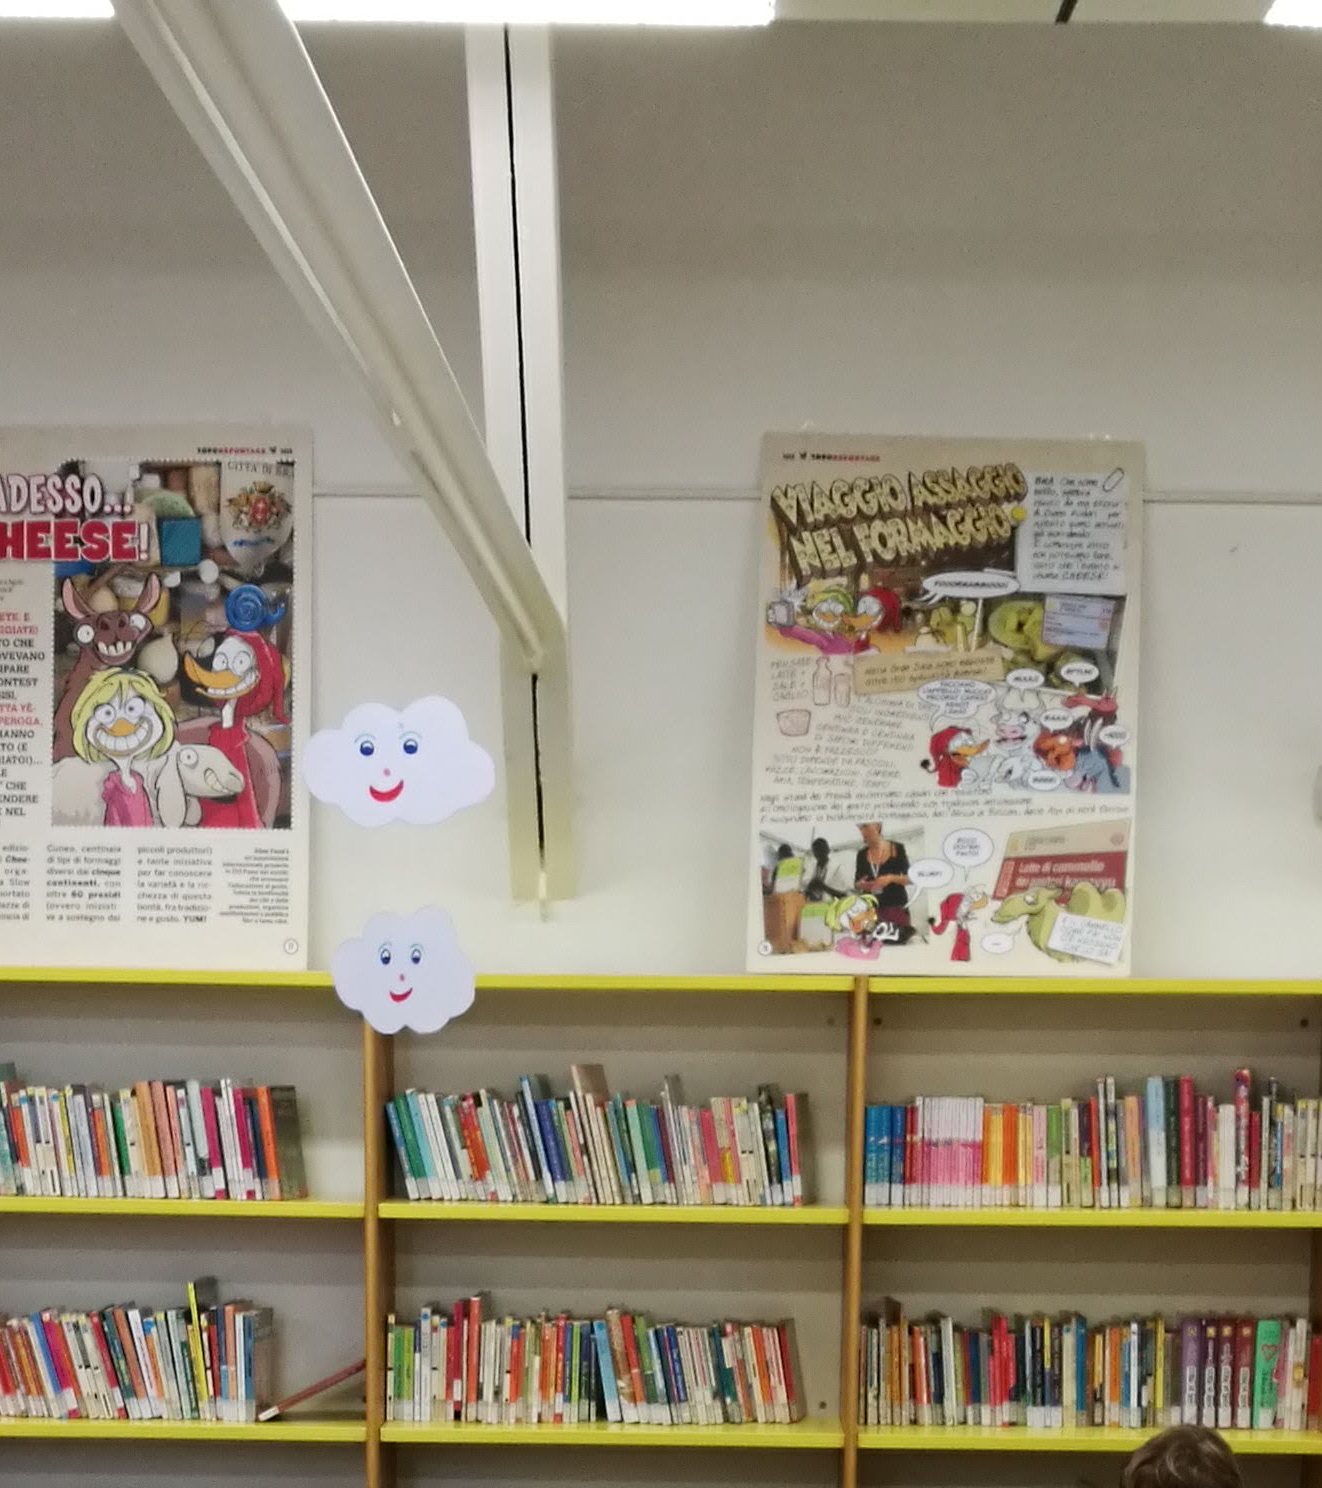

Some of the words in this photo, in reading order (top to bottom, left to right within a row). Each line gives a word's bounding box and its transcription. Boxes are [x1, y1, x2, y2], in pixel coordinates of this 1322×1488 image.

[773, 474, 907, 526] VIAGGIO
[790, 525, 857, 578] NEL
[854, 505, 1012, 566] FORMAGGIO
[13, 639, 34, 648] CHE
[5, 781, 27, 790] CHE
[5, 807, 26, 816] NEL
